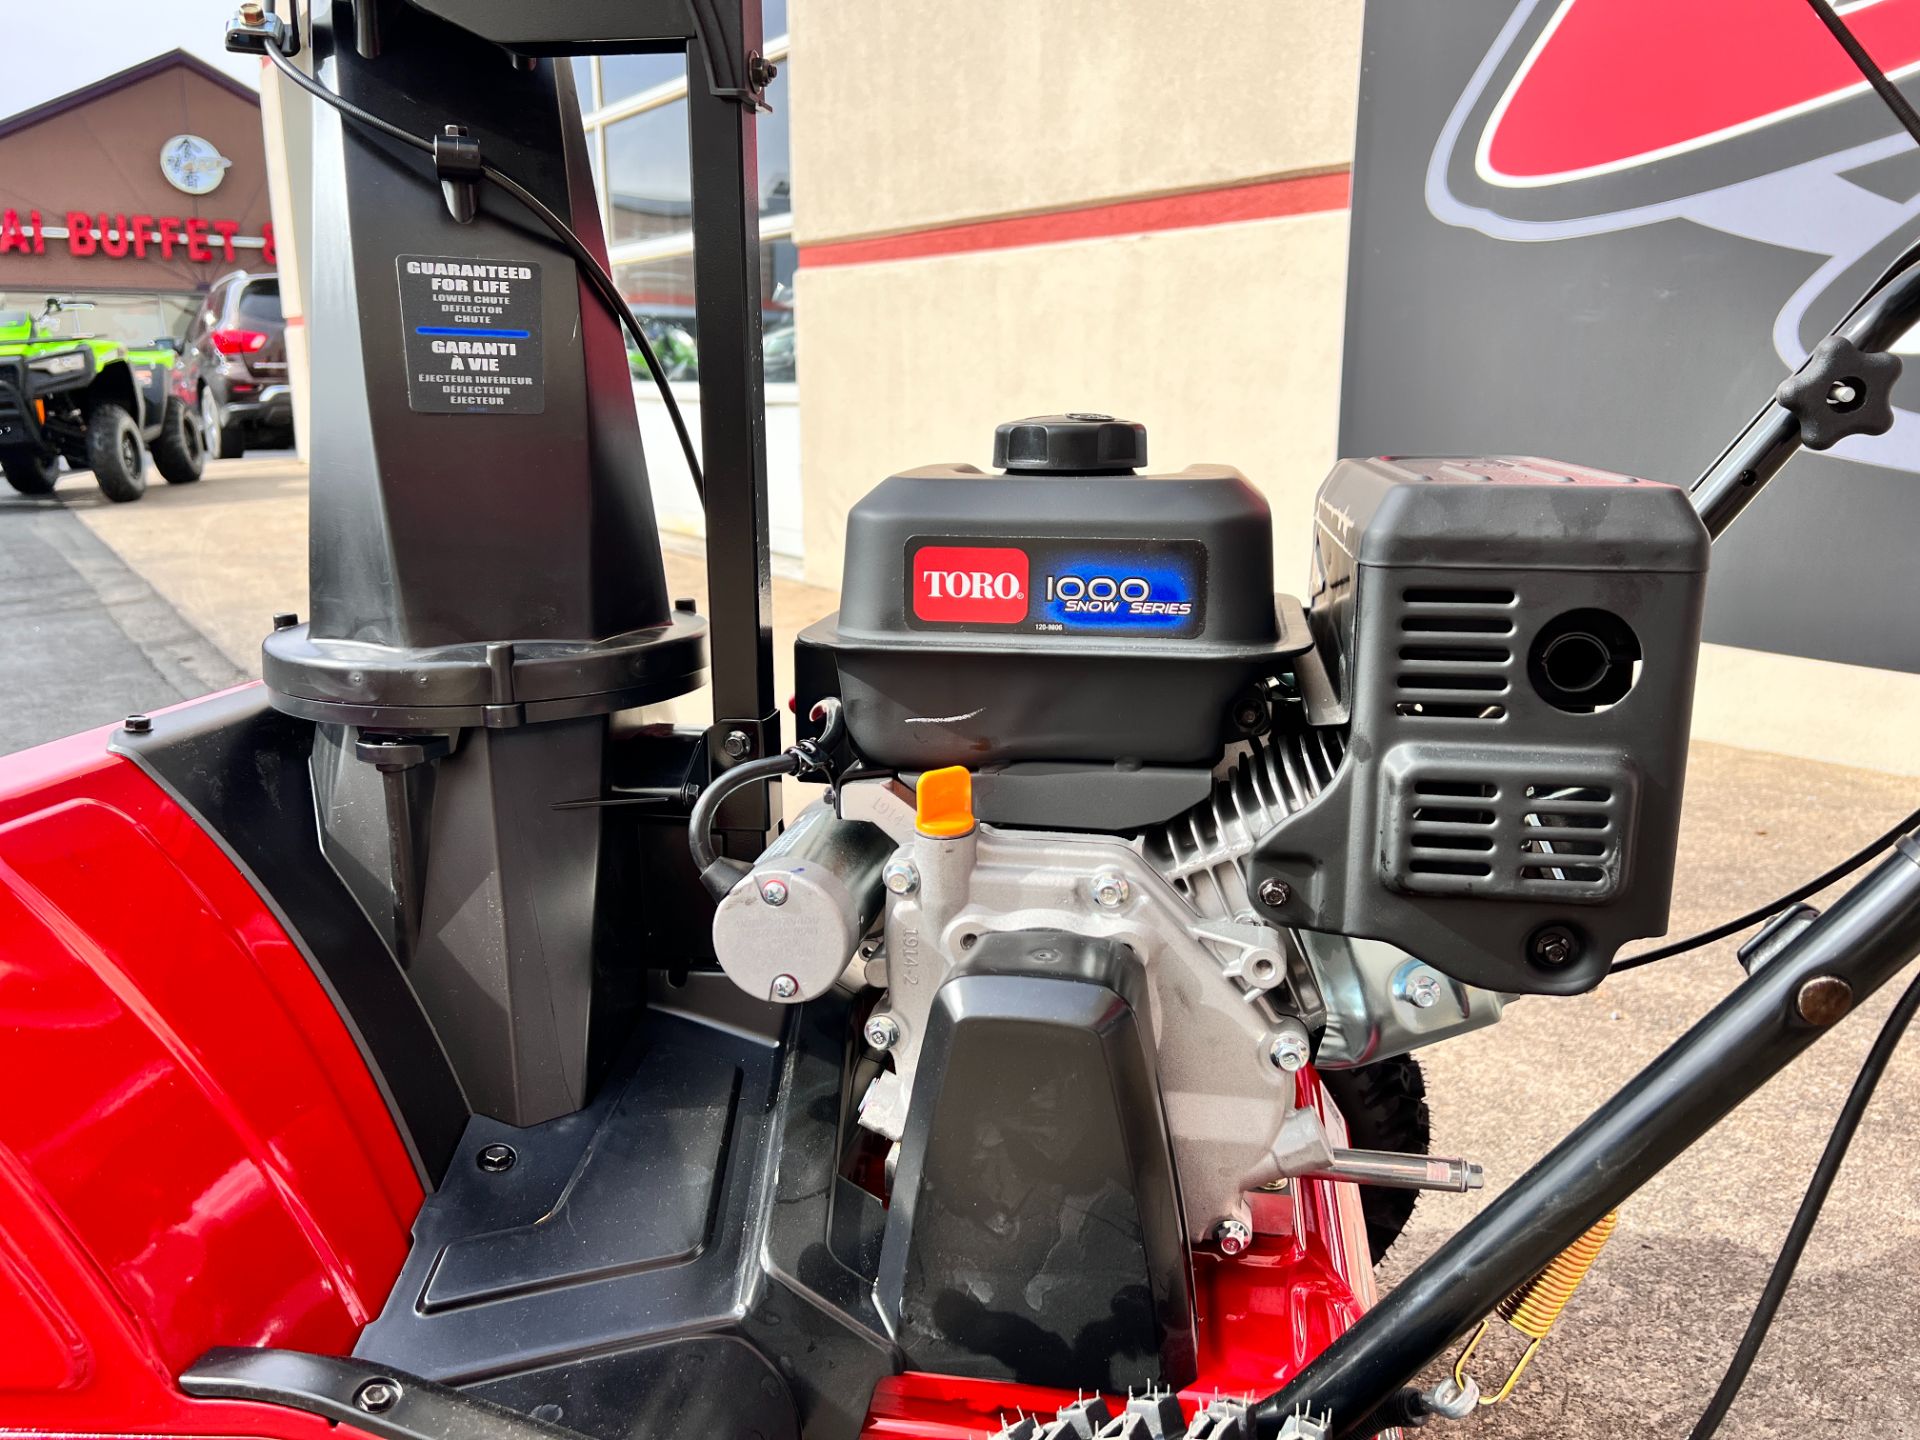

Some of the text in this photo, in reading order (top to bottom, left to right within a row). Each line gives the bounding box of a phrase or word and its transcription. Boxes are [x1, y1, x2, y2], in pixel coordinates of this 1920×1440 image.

[66, 211, 241, 264] BUFFET
[406, 261, 532, 280] GUARANTEED
[431, 277, 510, 294] FOR LIFE
[432, 293, 511, 305] LOWER CHUTE
[441, 304, 503, 314] DEFLECTOR
[454, 314, 491, 324] CHUTE
[431, 340, 517, 356] GARANTI
[467, 357, 500, 372] VIE
[923, 570, 1020, 600] TORO
[1046, 575, 1150, 602] 1000
[1064, 600, 1192, 615] SNOW SERIES
